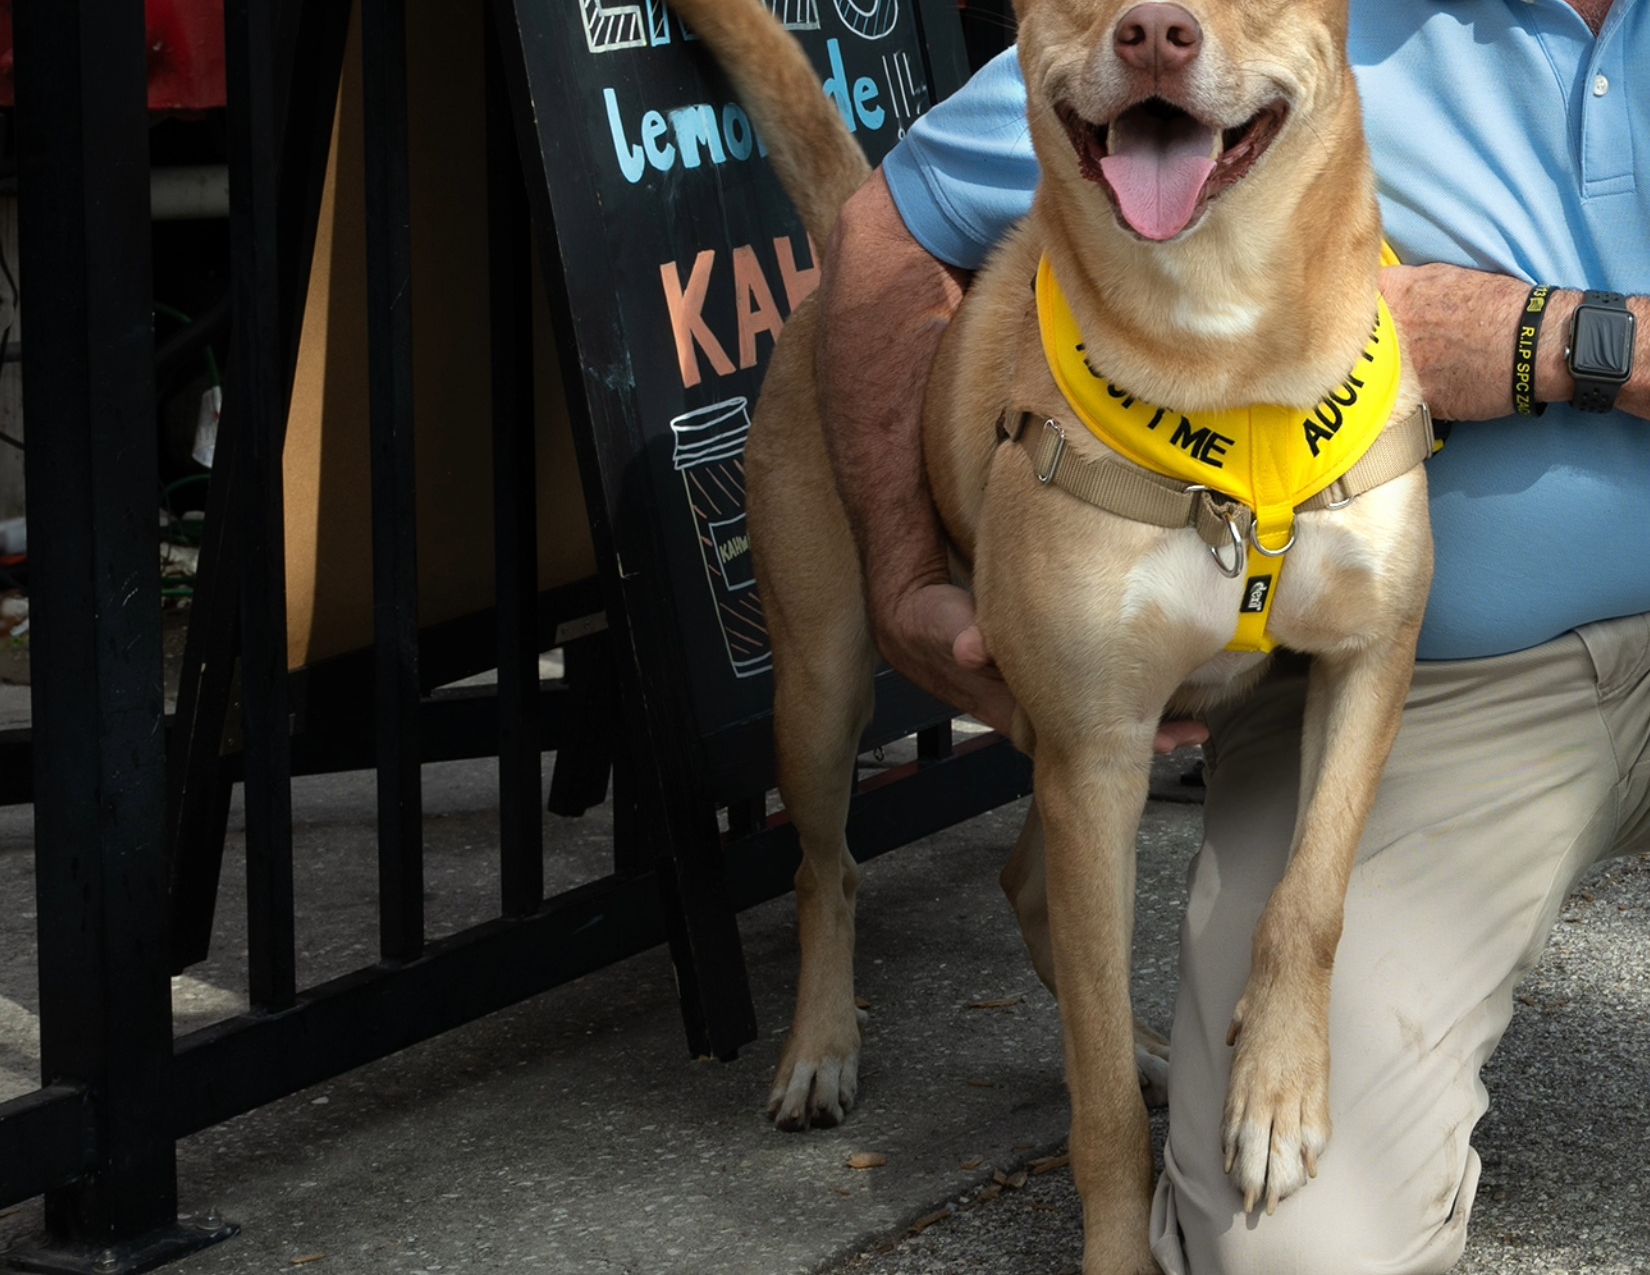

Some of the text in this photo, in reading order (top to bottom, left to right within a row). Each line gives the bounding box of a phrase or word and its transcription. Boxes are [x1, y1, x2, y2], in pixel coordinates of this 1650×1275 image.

[660, 231, 822, 388] KAH
[1515, 363, 1531, 392] SPC
[1169, 415, 1236, 469] ME
